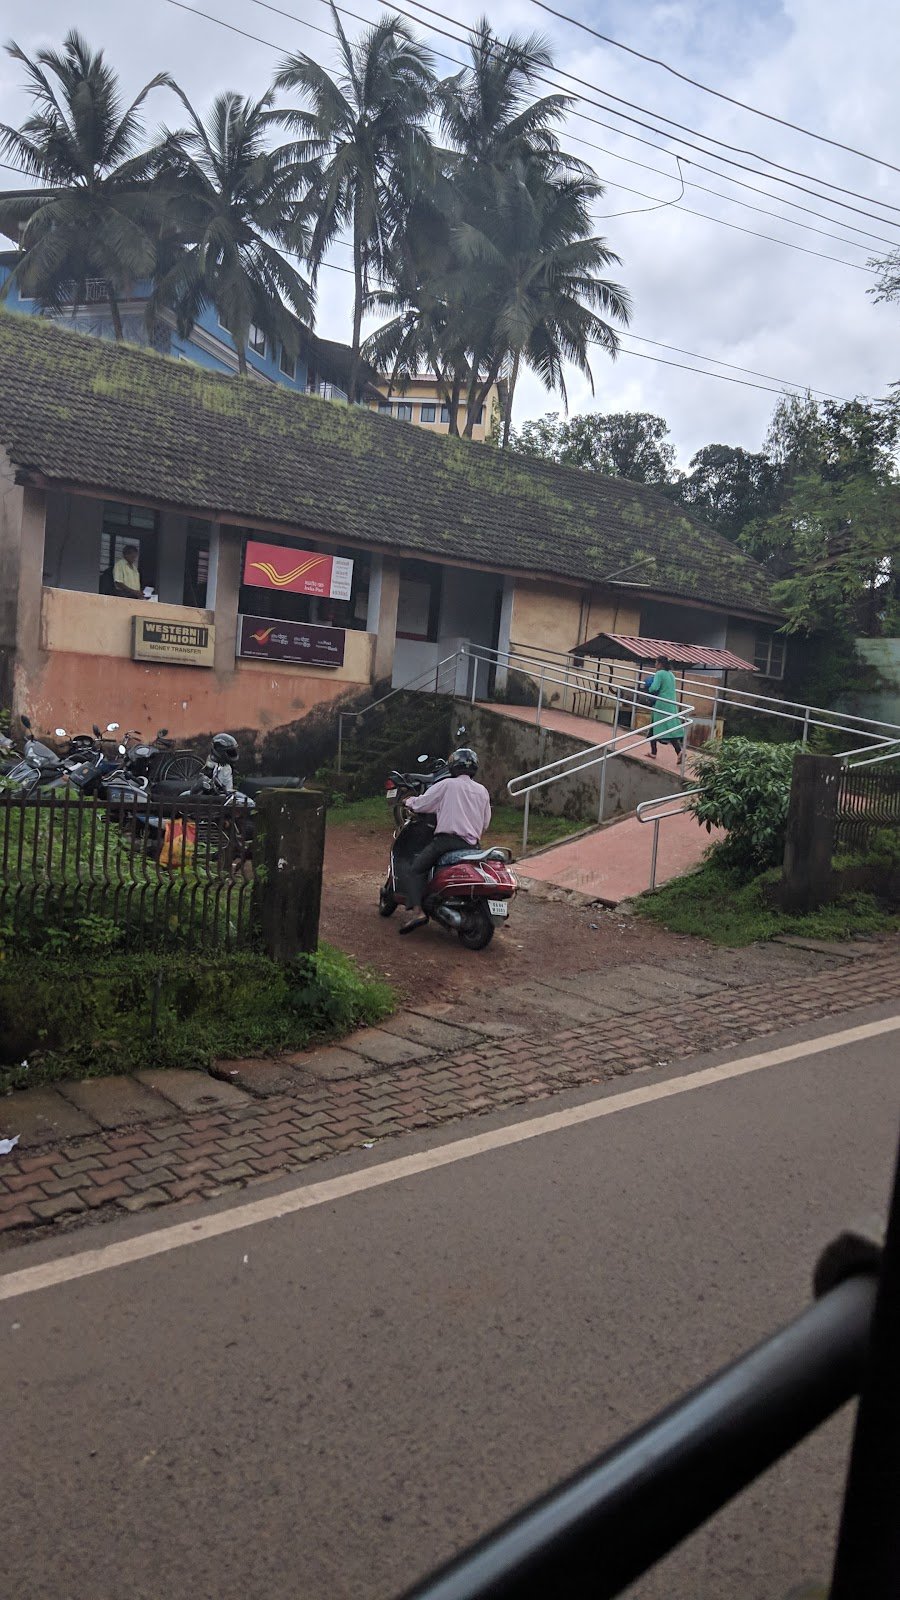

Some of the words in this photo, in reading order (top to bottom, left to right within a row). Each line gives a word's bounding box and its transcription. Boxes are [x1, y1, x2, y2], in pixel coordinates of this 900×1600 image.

[146, 624, 196, 636] WESTERN
[161, 634, 196, 644] UNION
[172, 646, 202, 654] TRANSFER
